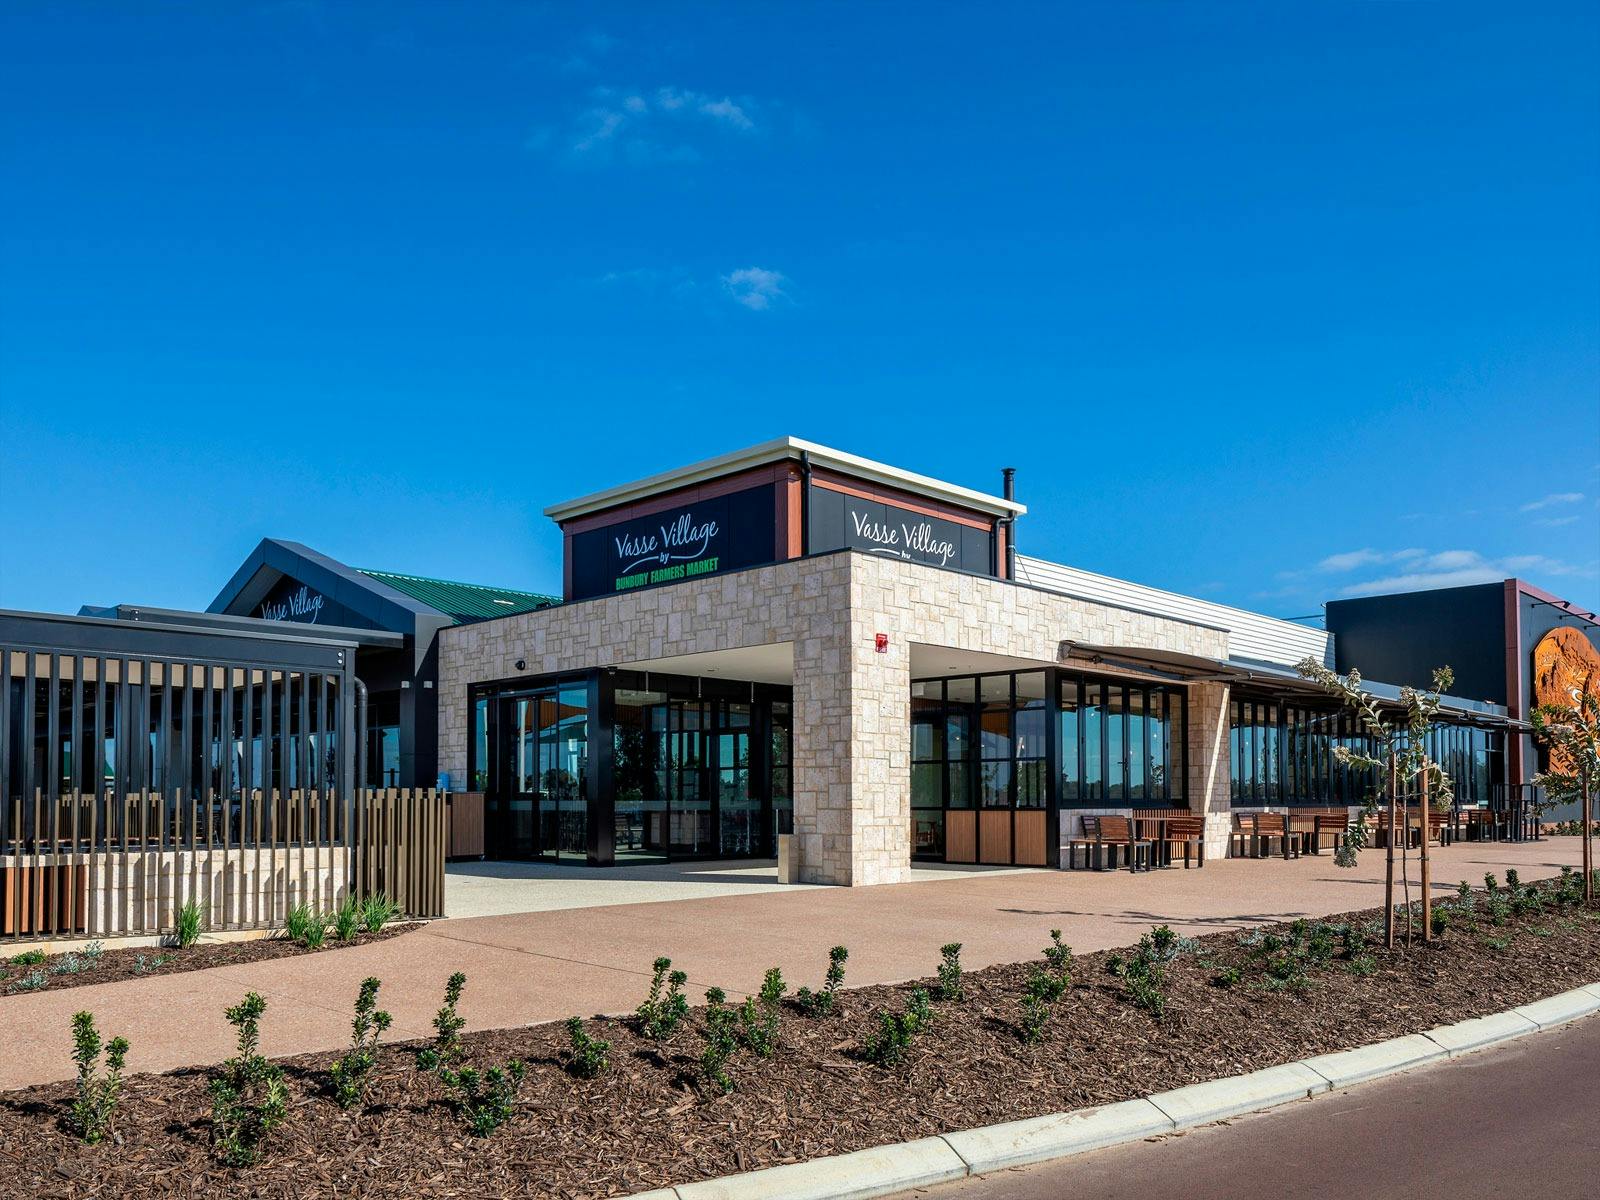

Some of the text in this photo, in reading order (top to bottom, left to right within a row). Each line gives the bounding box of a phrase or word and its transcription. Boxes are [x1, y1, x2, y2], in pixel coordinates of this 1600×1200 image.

[615, 513, 719, 558] Vasse Village
[852, 511, 955, 566] Vasse Village
[616, 557, 719, 591] BUNBURY FARMERS MARKET
[659, 552, 669, 564] by
[261, 586, 324, 624] Vasse Village
